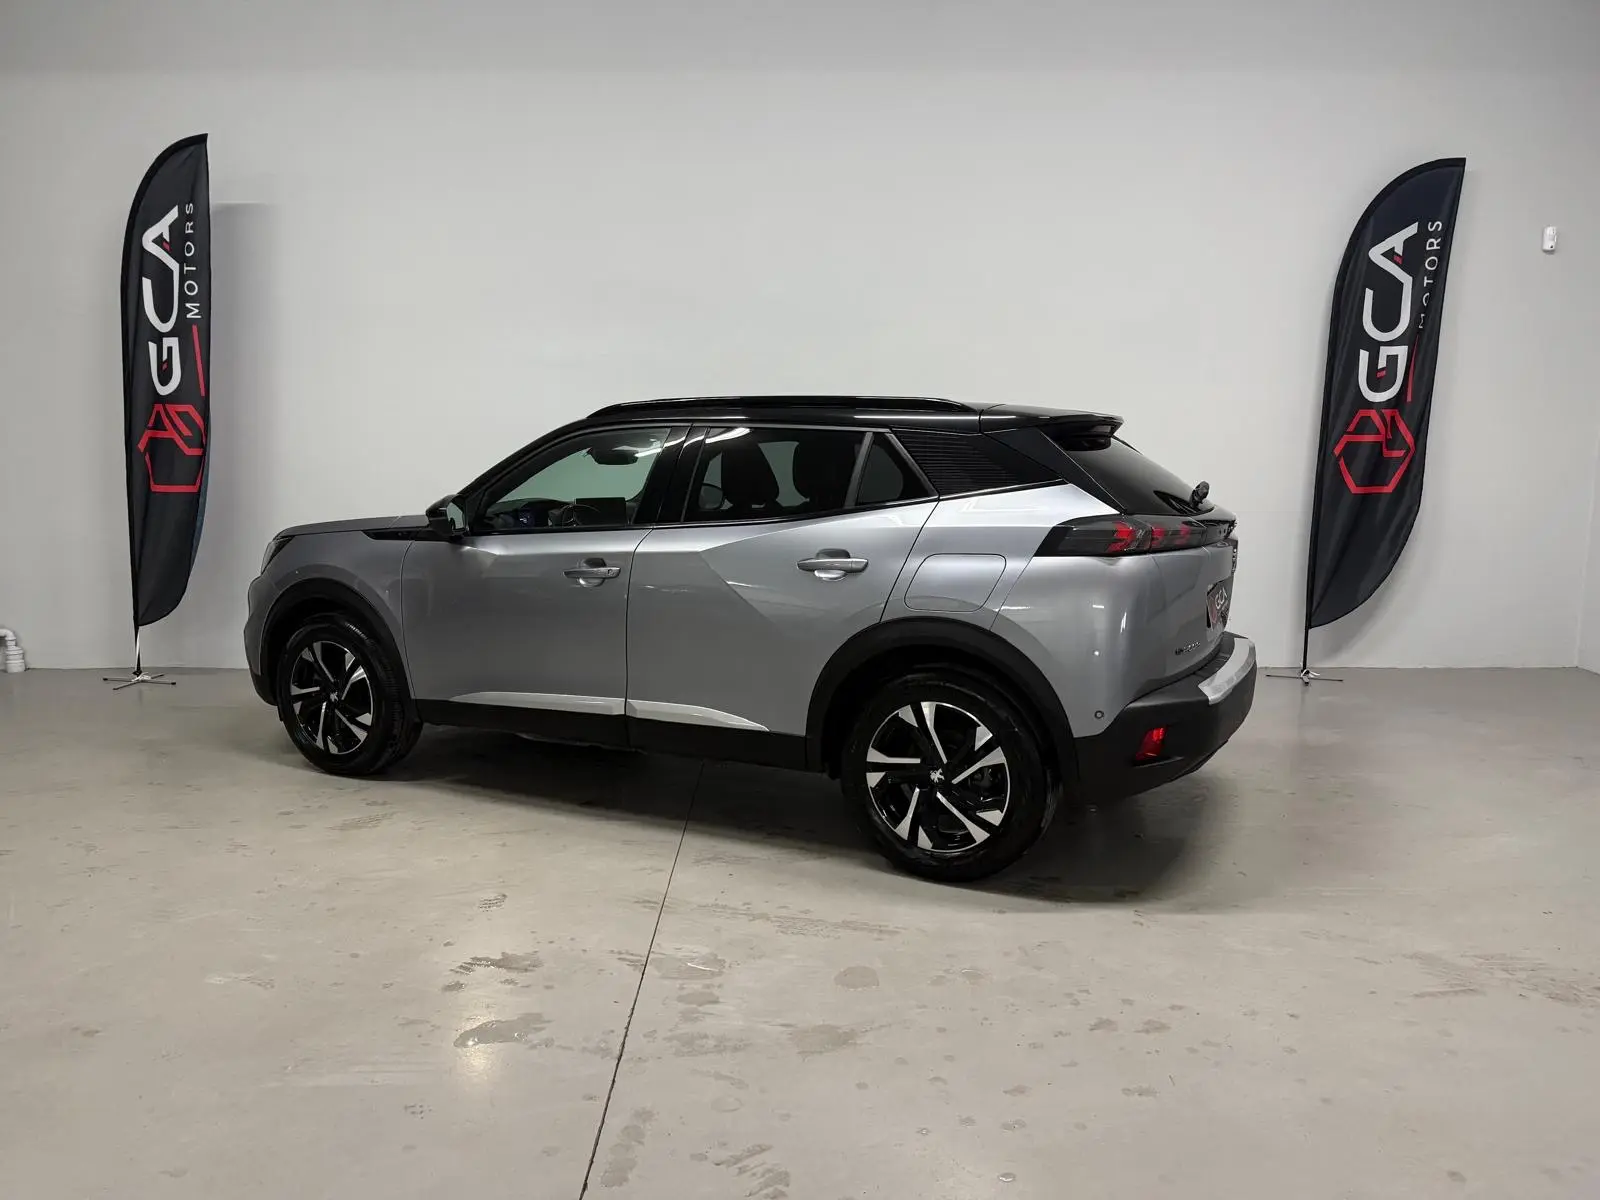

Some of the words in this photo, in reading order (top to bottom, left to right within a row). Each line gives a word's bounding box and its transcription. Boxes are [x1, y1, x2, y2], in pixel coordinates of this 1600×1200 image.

[141, 205, 181, 396] GCA
[183, 202, 202, 319] MOTORS
[1358, 221, 1419, 403] GCA
